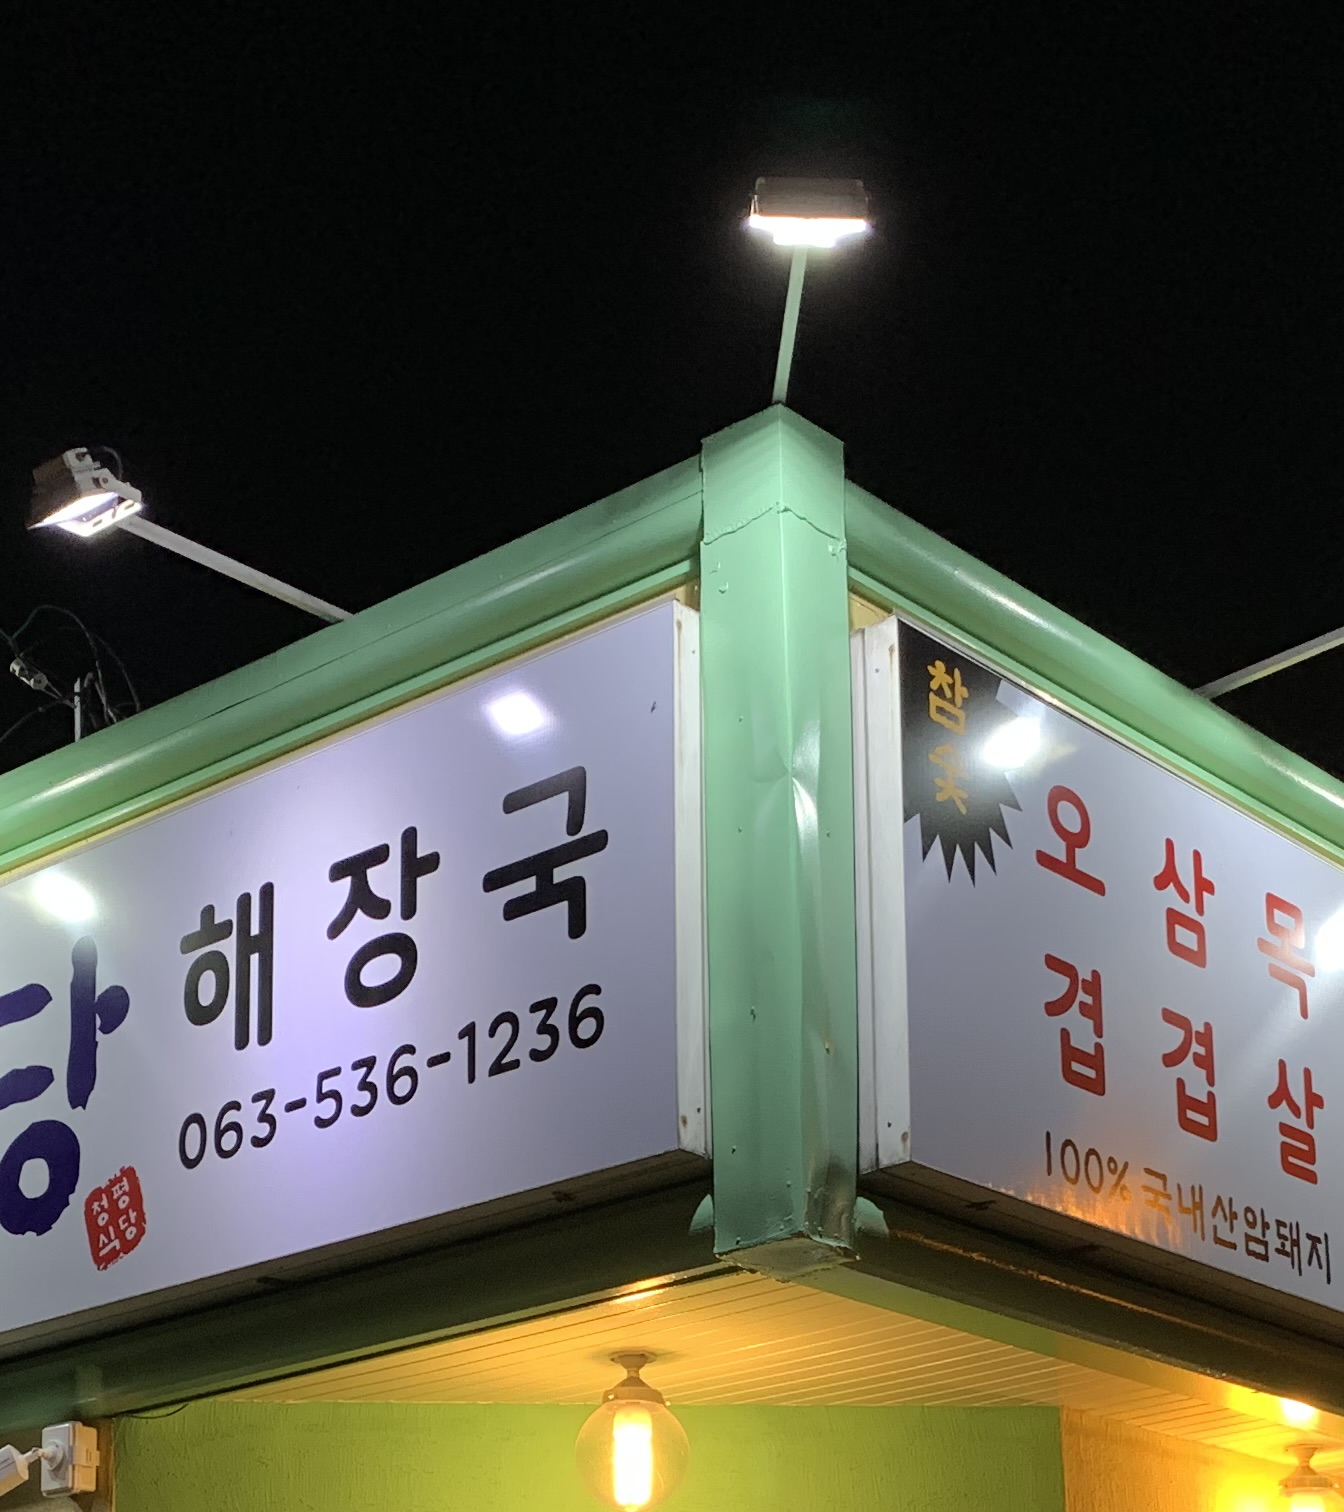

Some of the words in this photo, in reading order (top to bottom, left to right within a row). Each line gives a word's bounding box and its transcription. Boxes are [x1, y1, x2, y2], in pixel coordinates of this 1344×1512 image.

[927, 659, 970, 815] 참숯
[179, 765, 610, 1052] 해장국
[178, 983, 605, 1170] 063-536-1236
[1044, 1131, 1130, 1200] 100%
[1143, 1167, 1333, 1285] 국내산암돼지
